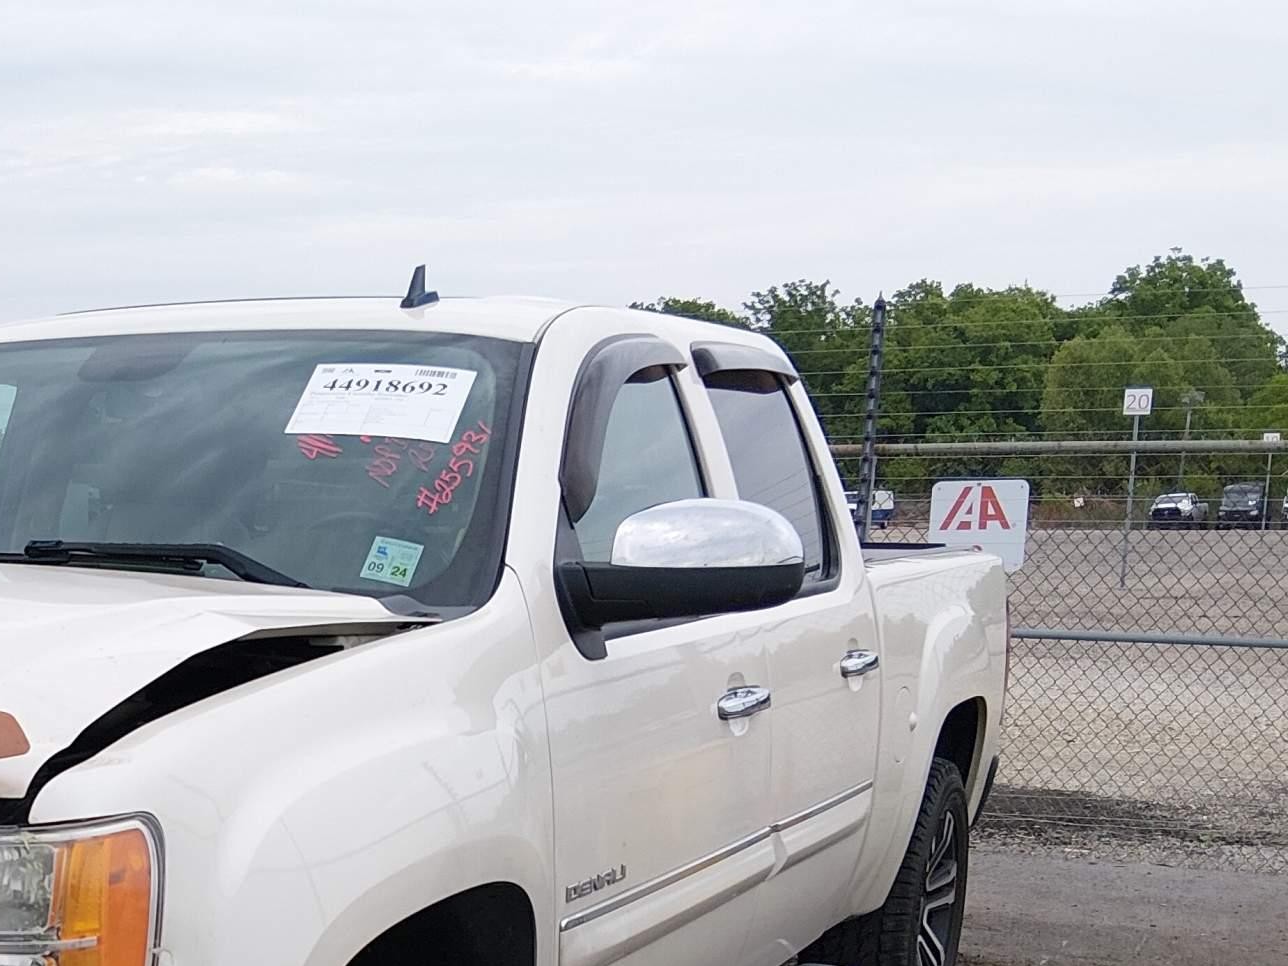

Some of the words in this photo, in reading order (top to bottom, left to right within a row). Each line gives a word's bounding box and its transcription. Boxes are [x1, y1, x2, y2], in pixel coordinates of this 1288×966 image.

[322, 377, 449, 397] 44918692
[1125, 393, 1151, 411] 20
[367, 560, 385, 574] 09
[390, 565, 408, 578] 24
